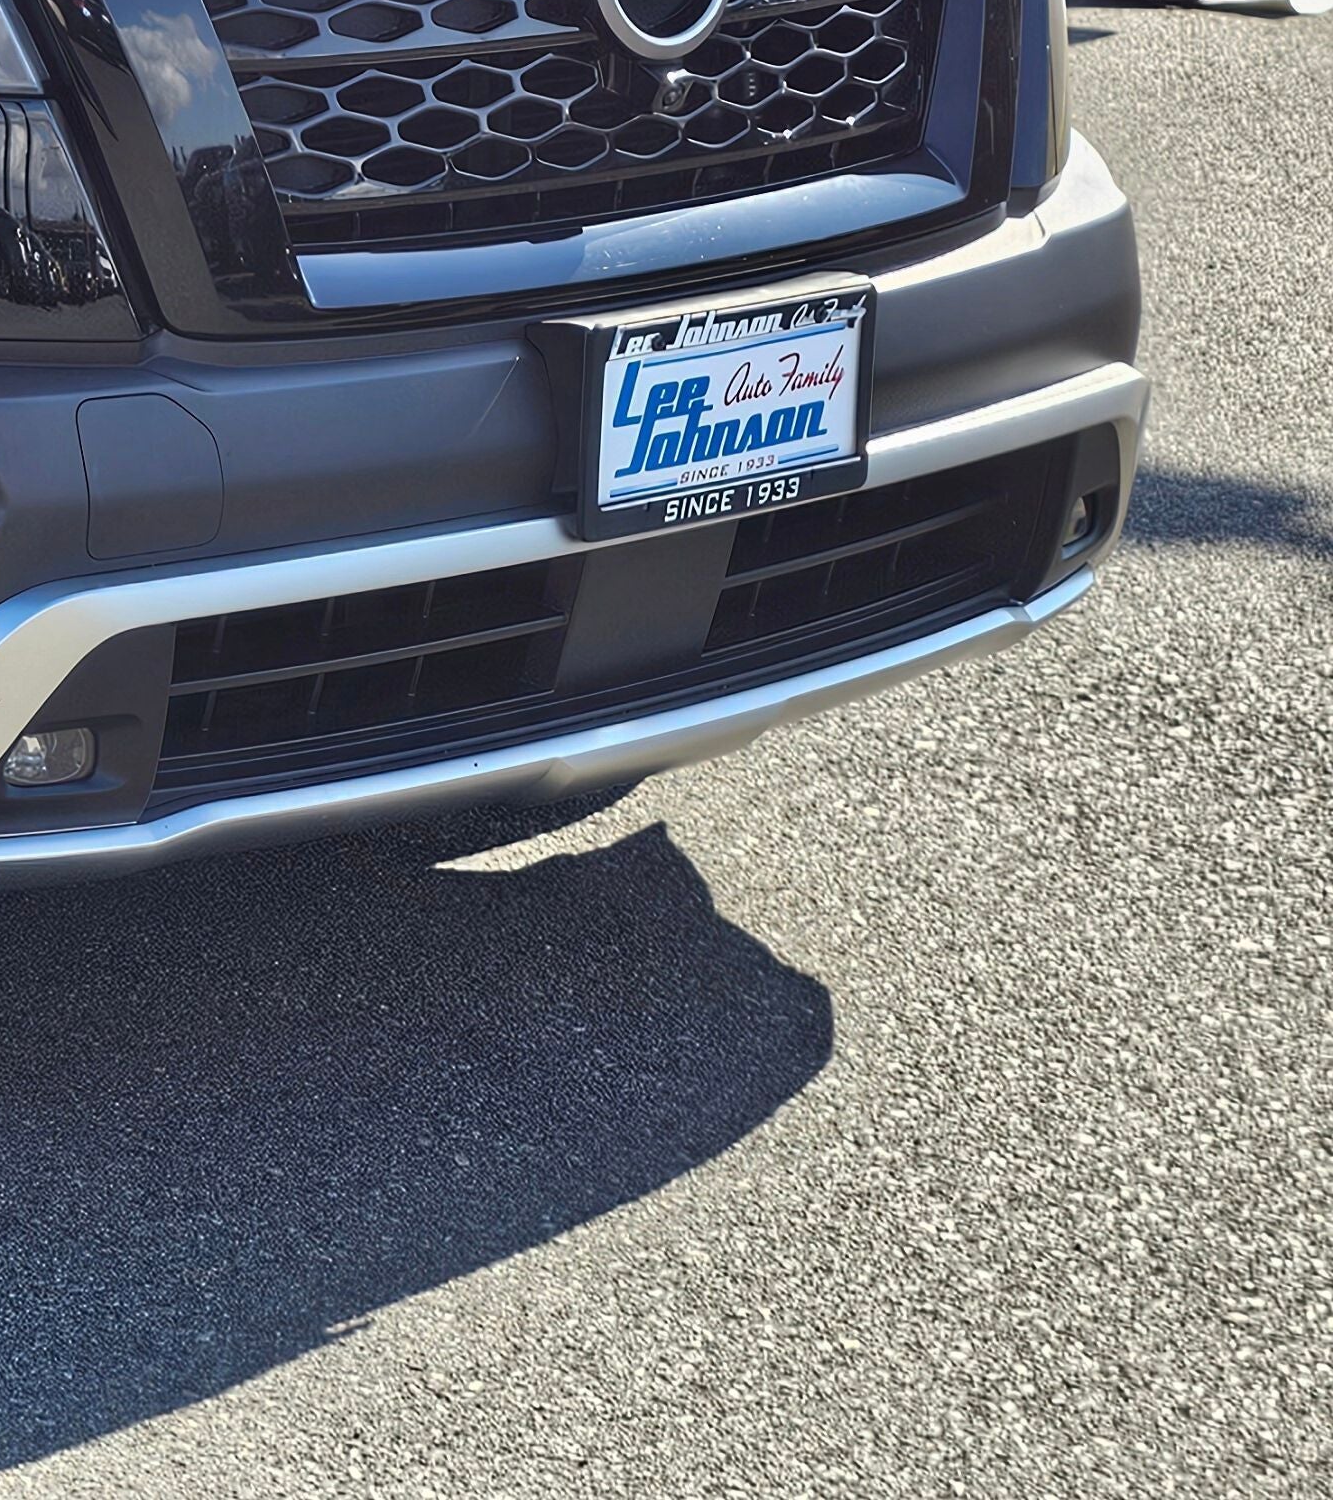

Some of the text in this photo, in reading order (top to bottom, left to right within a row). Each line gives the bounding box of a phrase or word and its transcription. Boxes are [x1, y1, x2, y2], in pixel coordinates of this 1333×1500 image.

[666, 310, 783, 350] Johnson
[613, 360, 713, 428] Lee
[724, 344, 845, 407] Auto Family
[614, 398, 828, 479] Johnson
[679, 454, 776, 484] SINCE 1933
[664, 476, 801, 522] SINCE 1933
